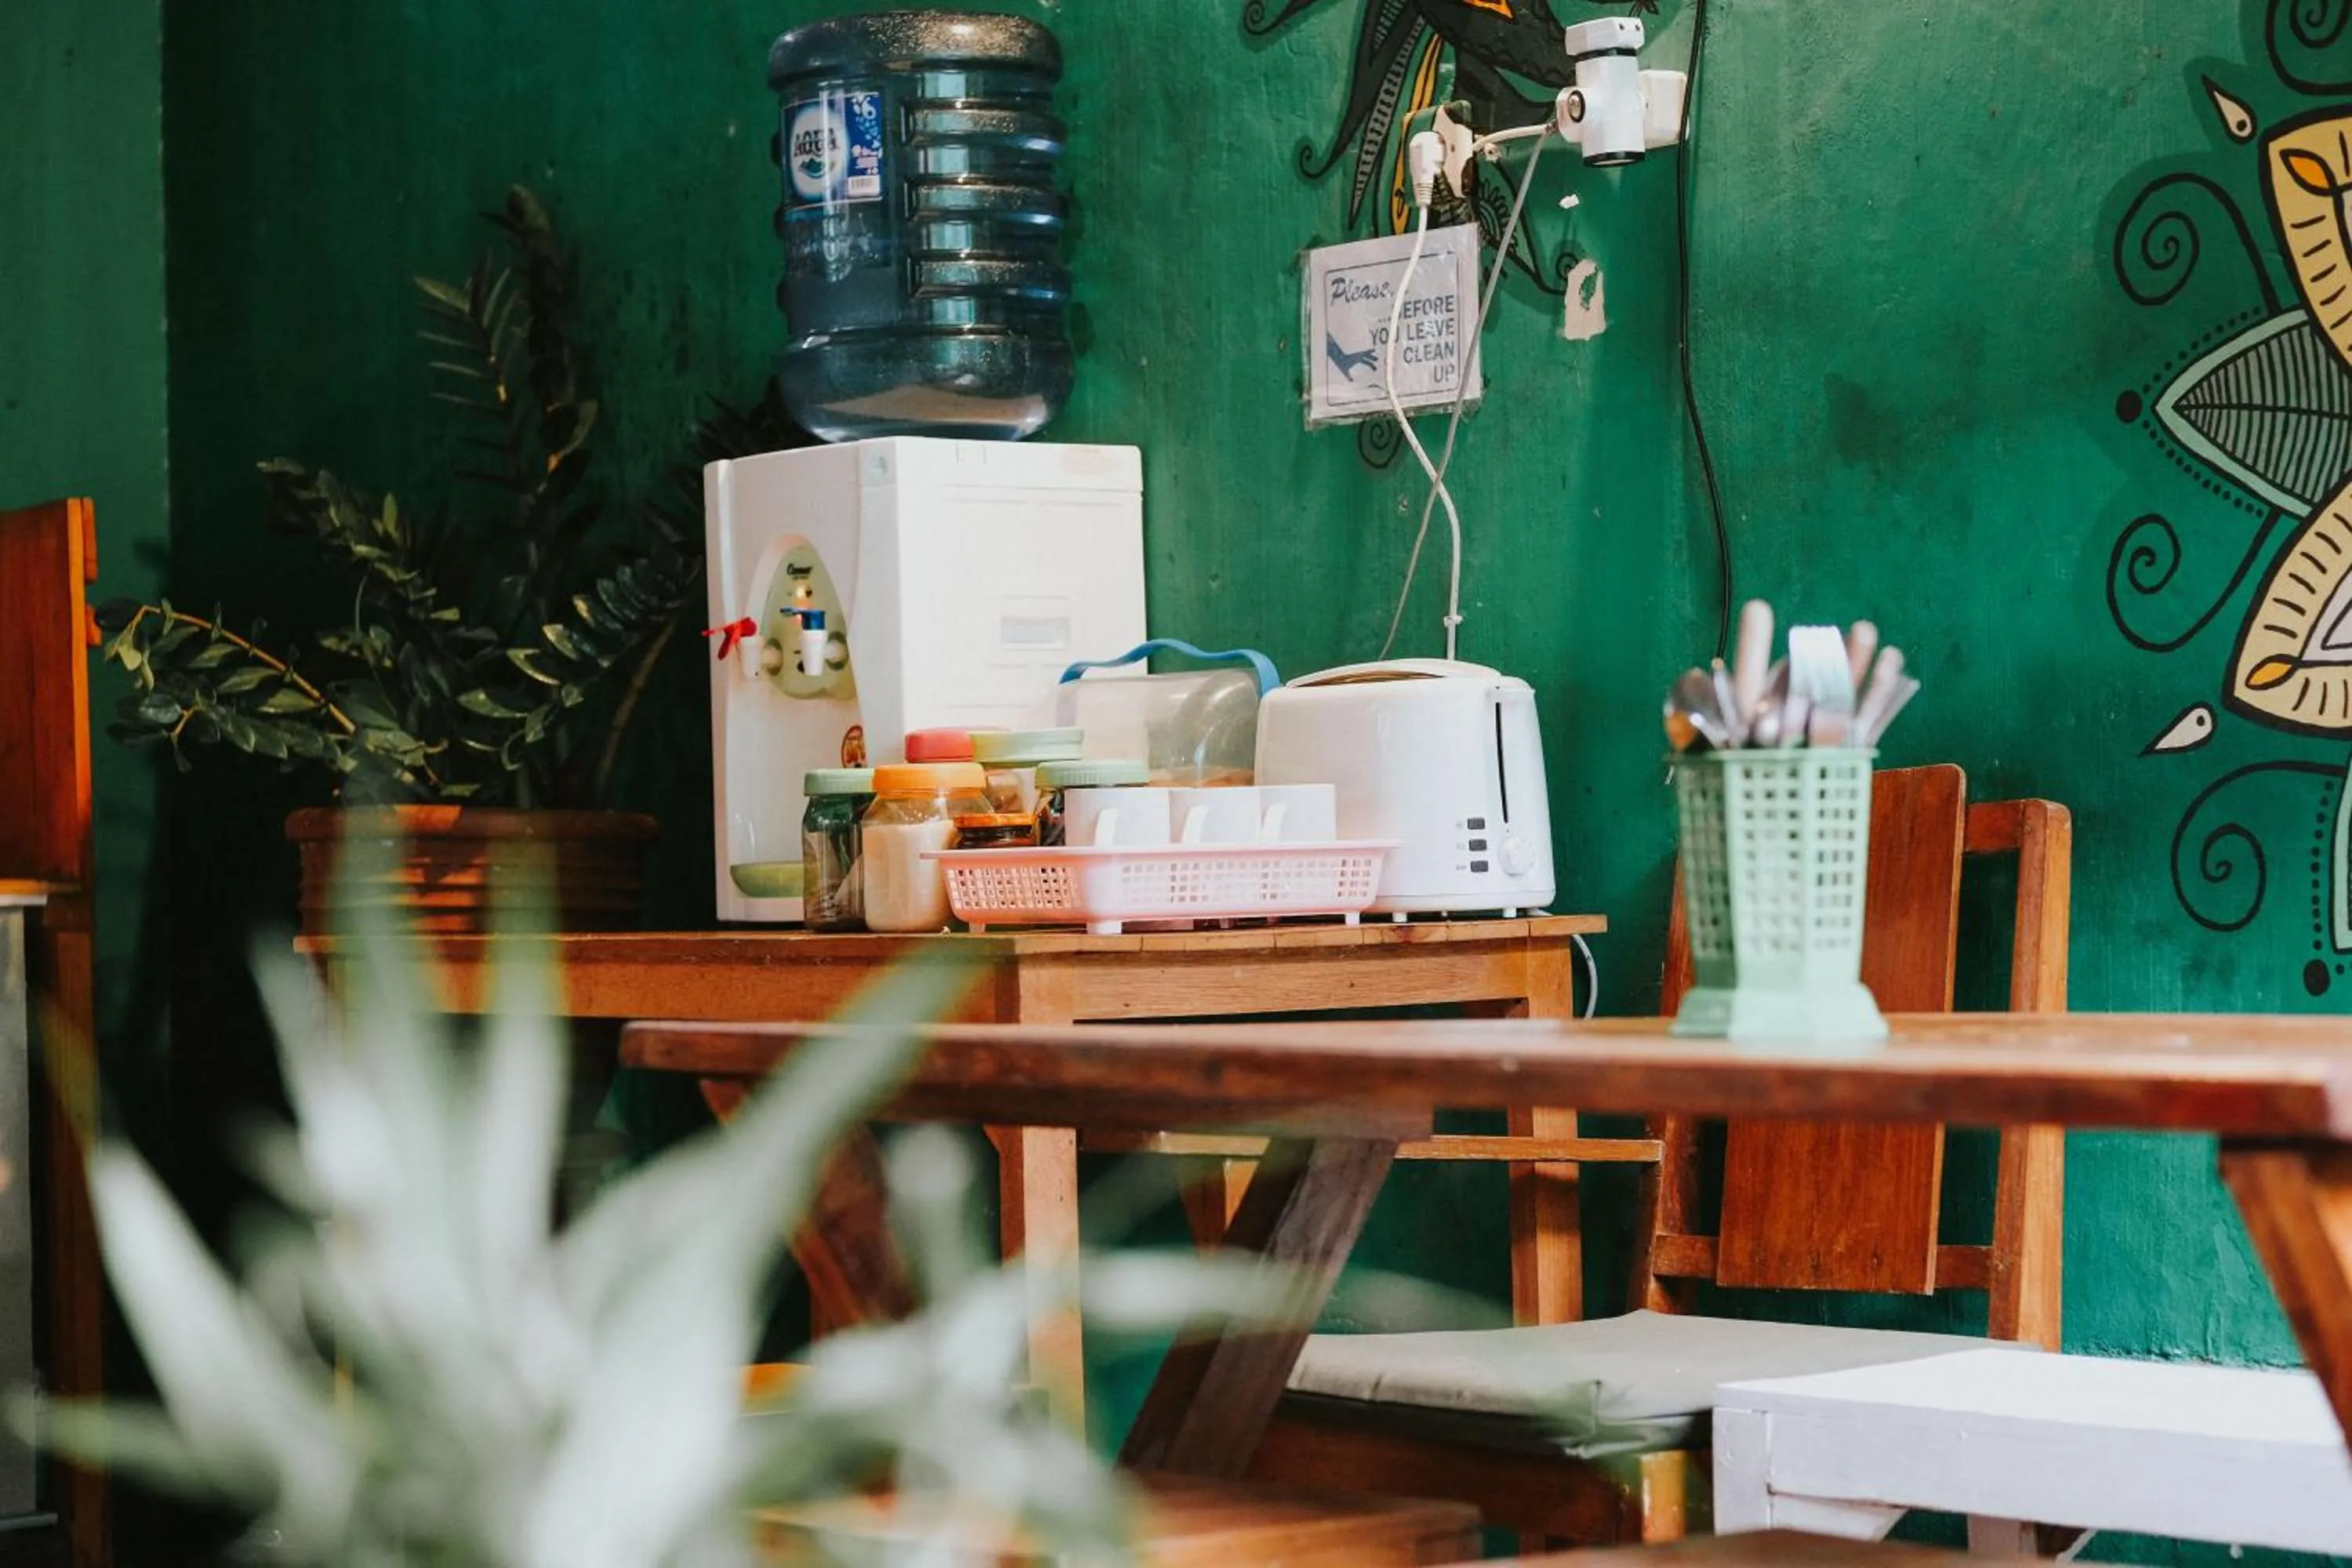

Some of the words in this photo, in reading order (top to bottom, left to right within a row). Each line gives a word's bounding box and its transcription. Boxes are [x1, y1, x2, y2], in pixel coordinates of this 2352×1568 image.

[1377, 295, 1454, 323] ...EFORE
[1407, 317, 1454, 340] LEAVE
[1403, 342, 1454, 364] CLEAN
[1433, 363, 1455, 383] UP
